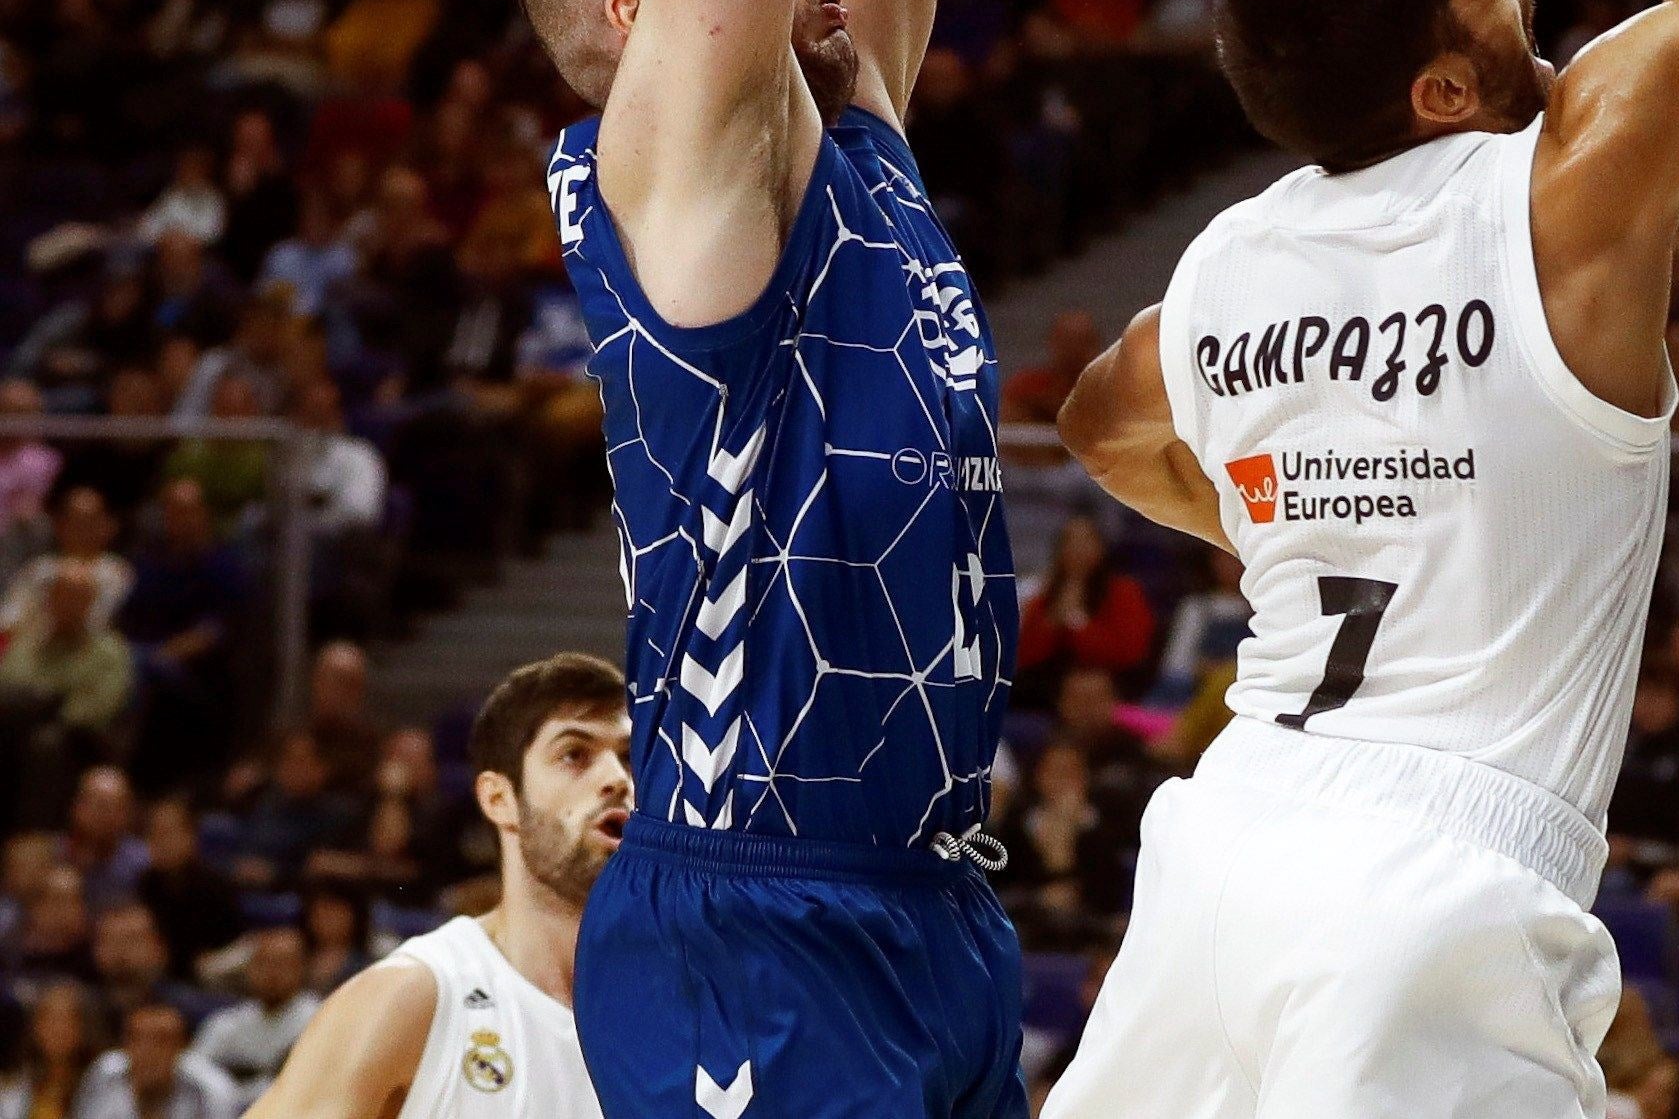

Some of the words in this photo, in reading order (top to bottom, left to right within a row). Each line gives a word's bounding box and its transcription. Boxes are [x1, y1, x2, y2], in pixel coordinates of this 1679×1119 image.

[1196, 298, 1495, 402] CAMPAZZO
[1282, 448, 1475, 482] Universidad
[1284, 491, 1417, 525] Europea
[1274, 576, 1399, 731] 7
